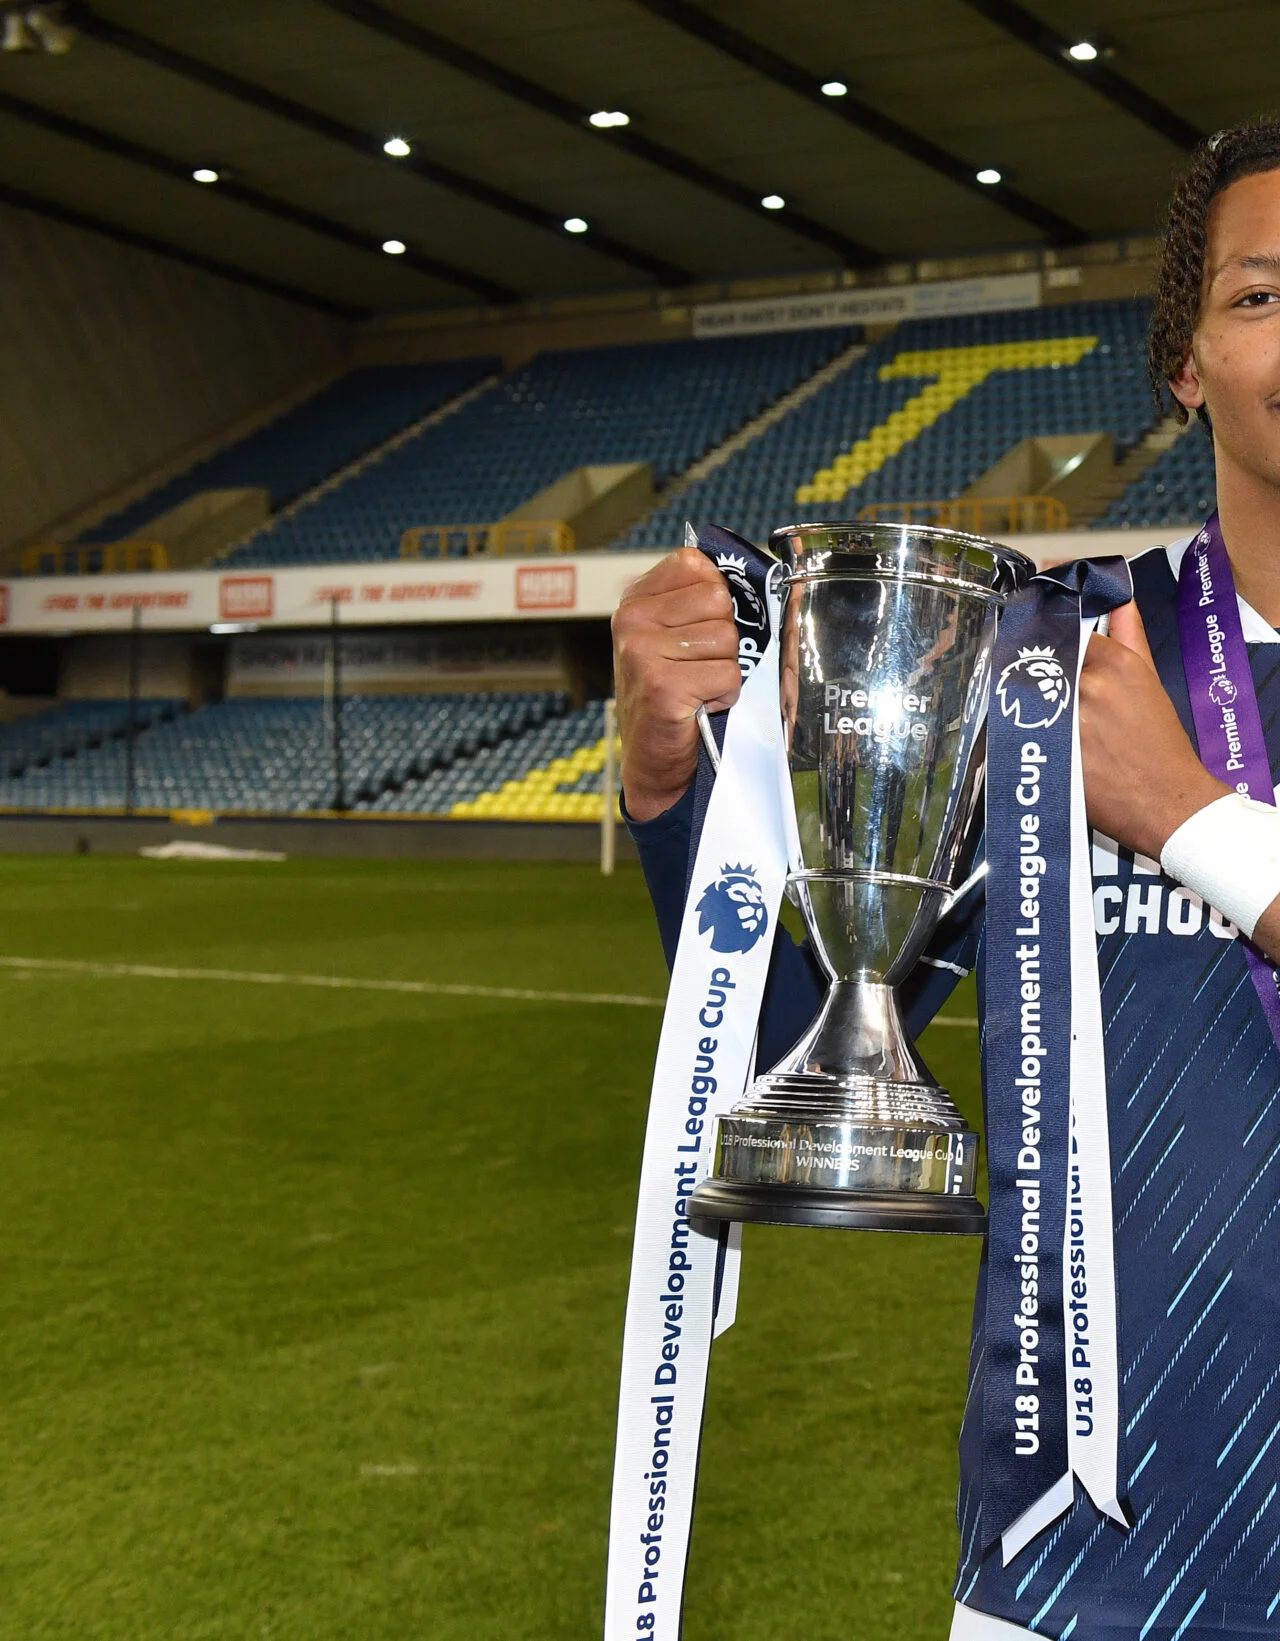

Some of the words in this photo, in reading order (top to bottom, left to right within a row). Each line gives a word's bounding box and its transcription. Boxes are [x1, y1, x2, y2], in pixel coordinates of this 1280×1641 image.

[1195, 554, 1215, 607] Premier
[738, 636, 764, 678] up
[1206, 614, 1226, 675] League
[1219, 706, 1245, 771] Premier
[1015, 741, 1048, 807] Cup
[1015, 813, 1048, 936] League
[698, 966, 737, 1029] Cup
[1015, 943, 1048, 1171] Development
[677, 1036, 718, 1153] League
[733, 1133, 797, 1151] Professional
[889, 1146, 933, 1162] League
[934, 1148, 954, 1163] Cup
[654, 1161, 698, 1386] Development
[1014, 1179, 1042, 1387] Professional
[1014, 1393, 1040, 1456] U18
[1073, 1377, 1094, 1438] U18
[637, 1395, 675, 1604] Professional
